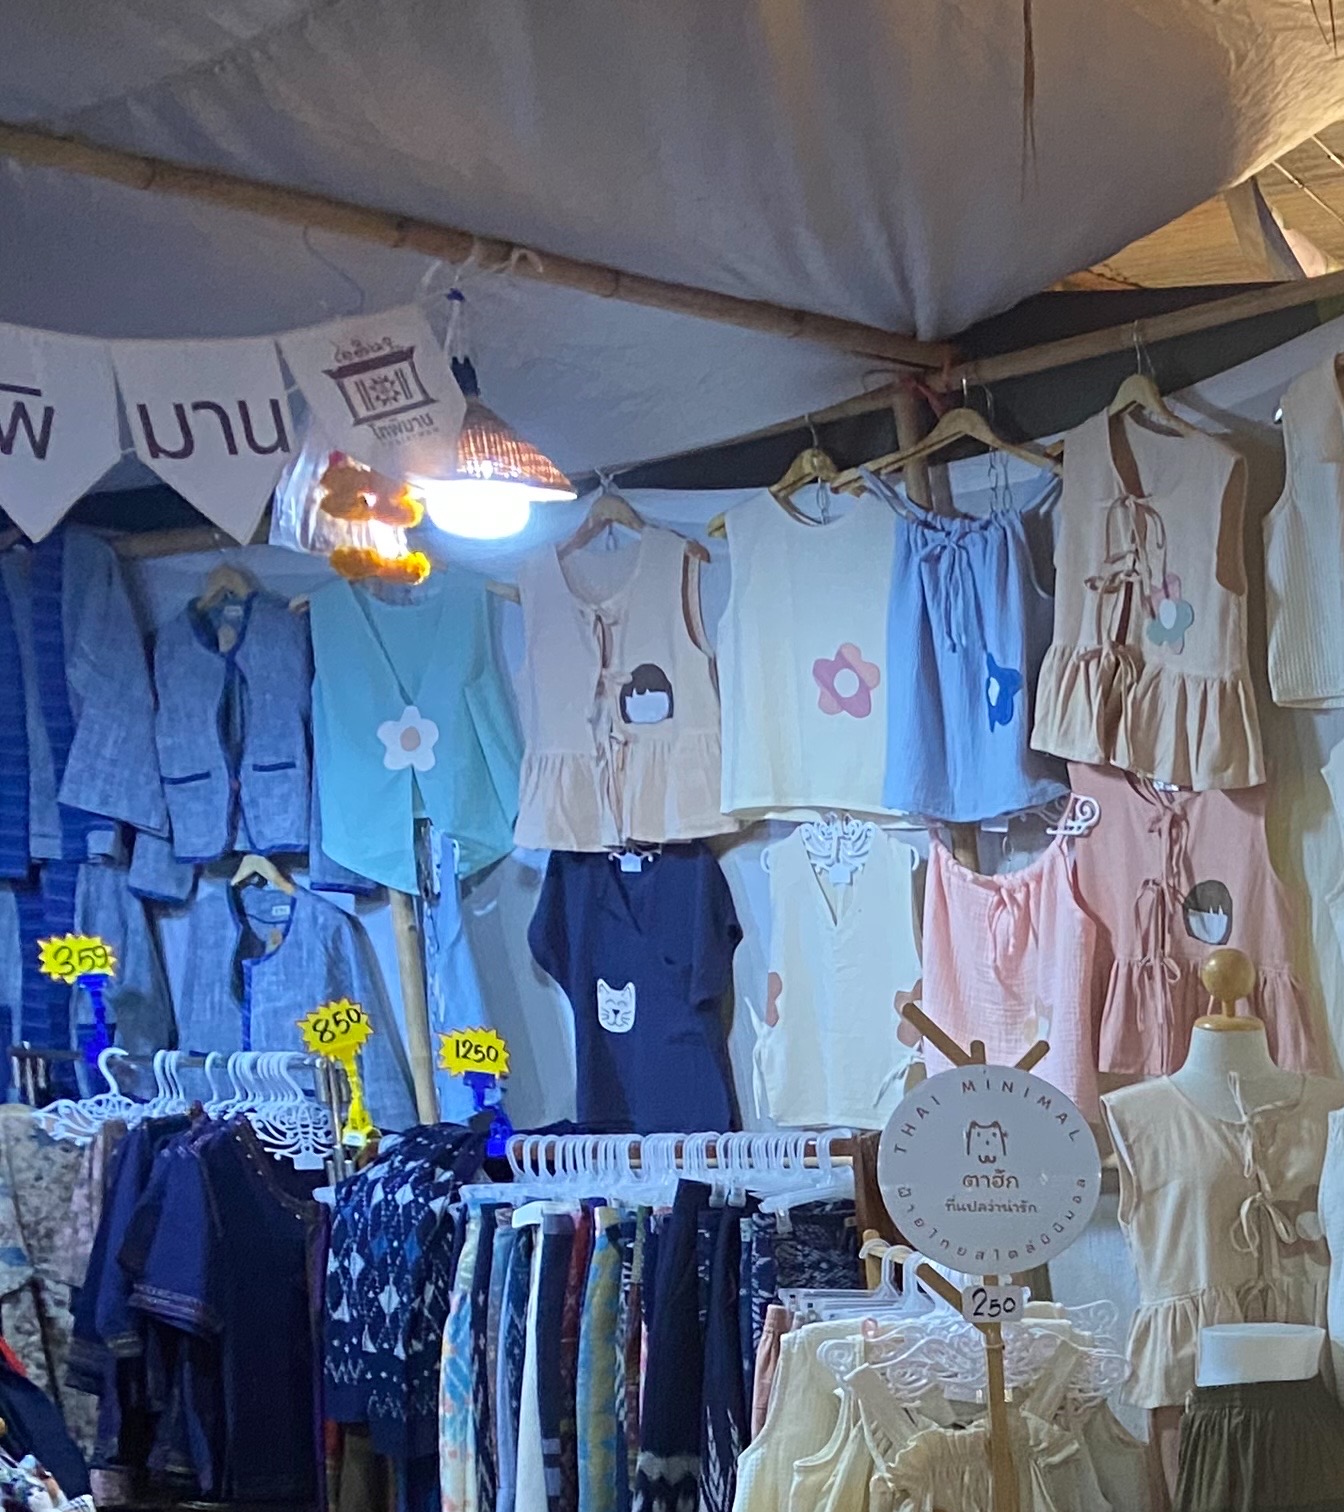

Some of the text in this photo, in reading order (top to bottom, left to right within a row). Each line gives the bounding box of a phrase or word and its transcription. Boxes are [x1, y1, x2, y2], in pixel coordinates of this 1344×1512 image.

[53, 945, 108, 976] 359
[312, 1007, 361, 1044] 850
[455, 1039, 499, 1063] 1250
[894, 1079, 1081, 1155] THAI MINIMAL
[972, 1287, 1016, 1318] 250
